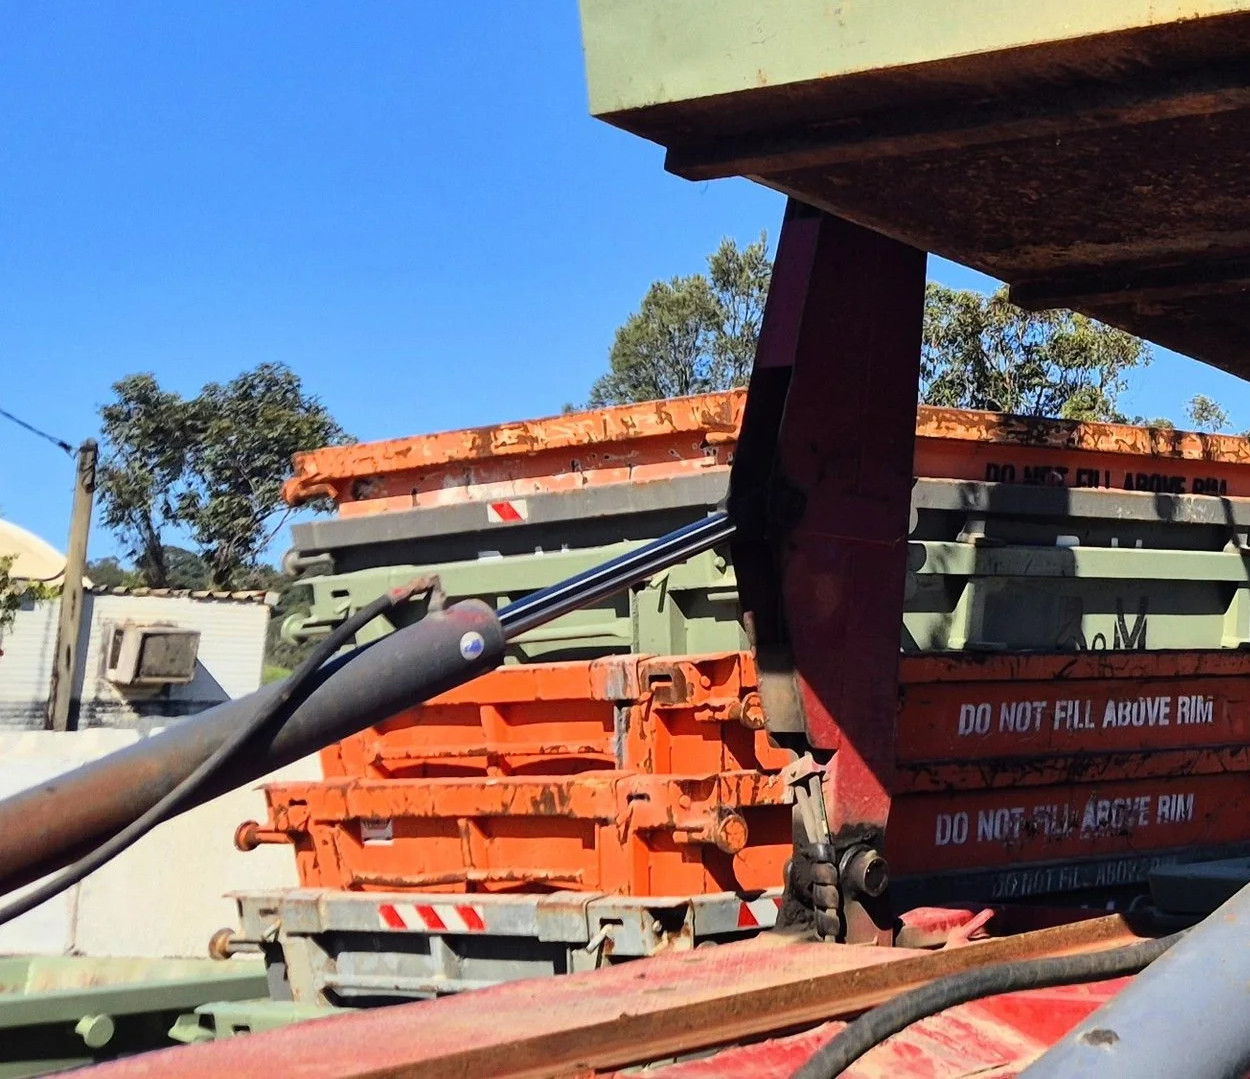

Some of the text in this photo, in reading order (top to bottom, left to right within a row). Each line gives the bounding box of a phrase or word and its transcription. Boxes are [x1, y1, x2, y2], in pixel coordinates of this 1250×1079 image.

[958, 695, 1214, 736] DO NOT FILL ABOVE RIM
[935, 811, 969, 846] DO
[977, 807, 1024, 842] NOT
[1156, 793, 1195, 825] RIM
